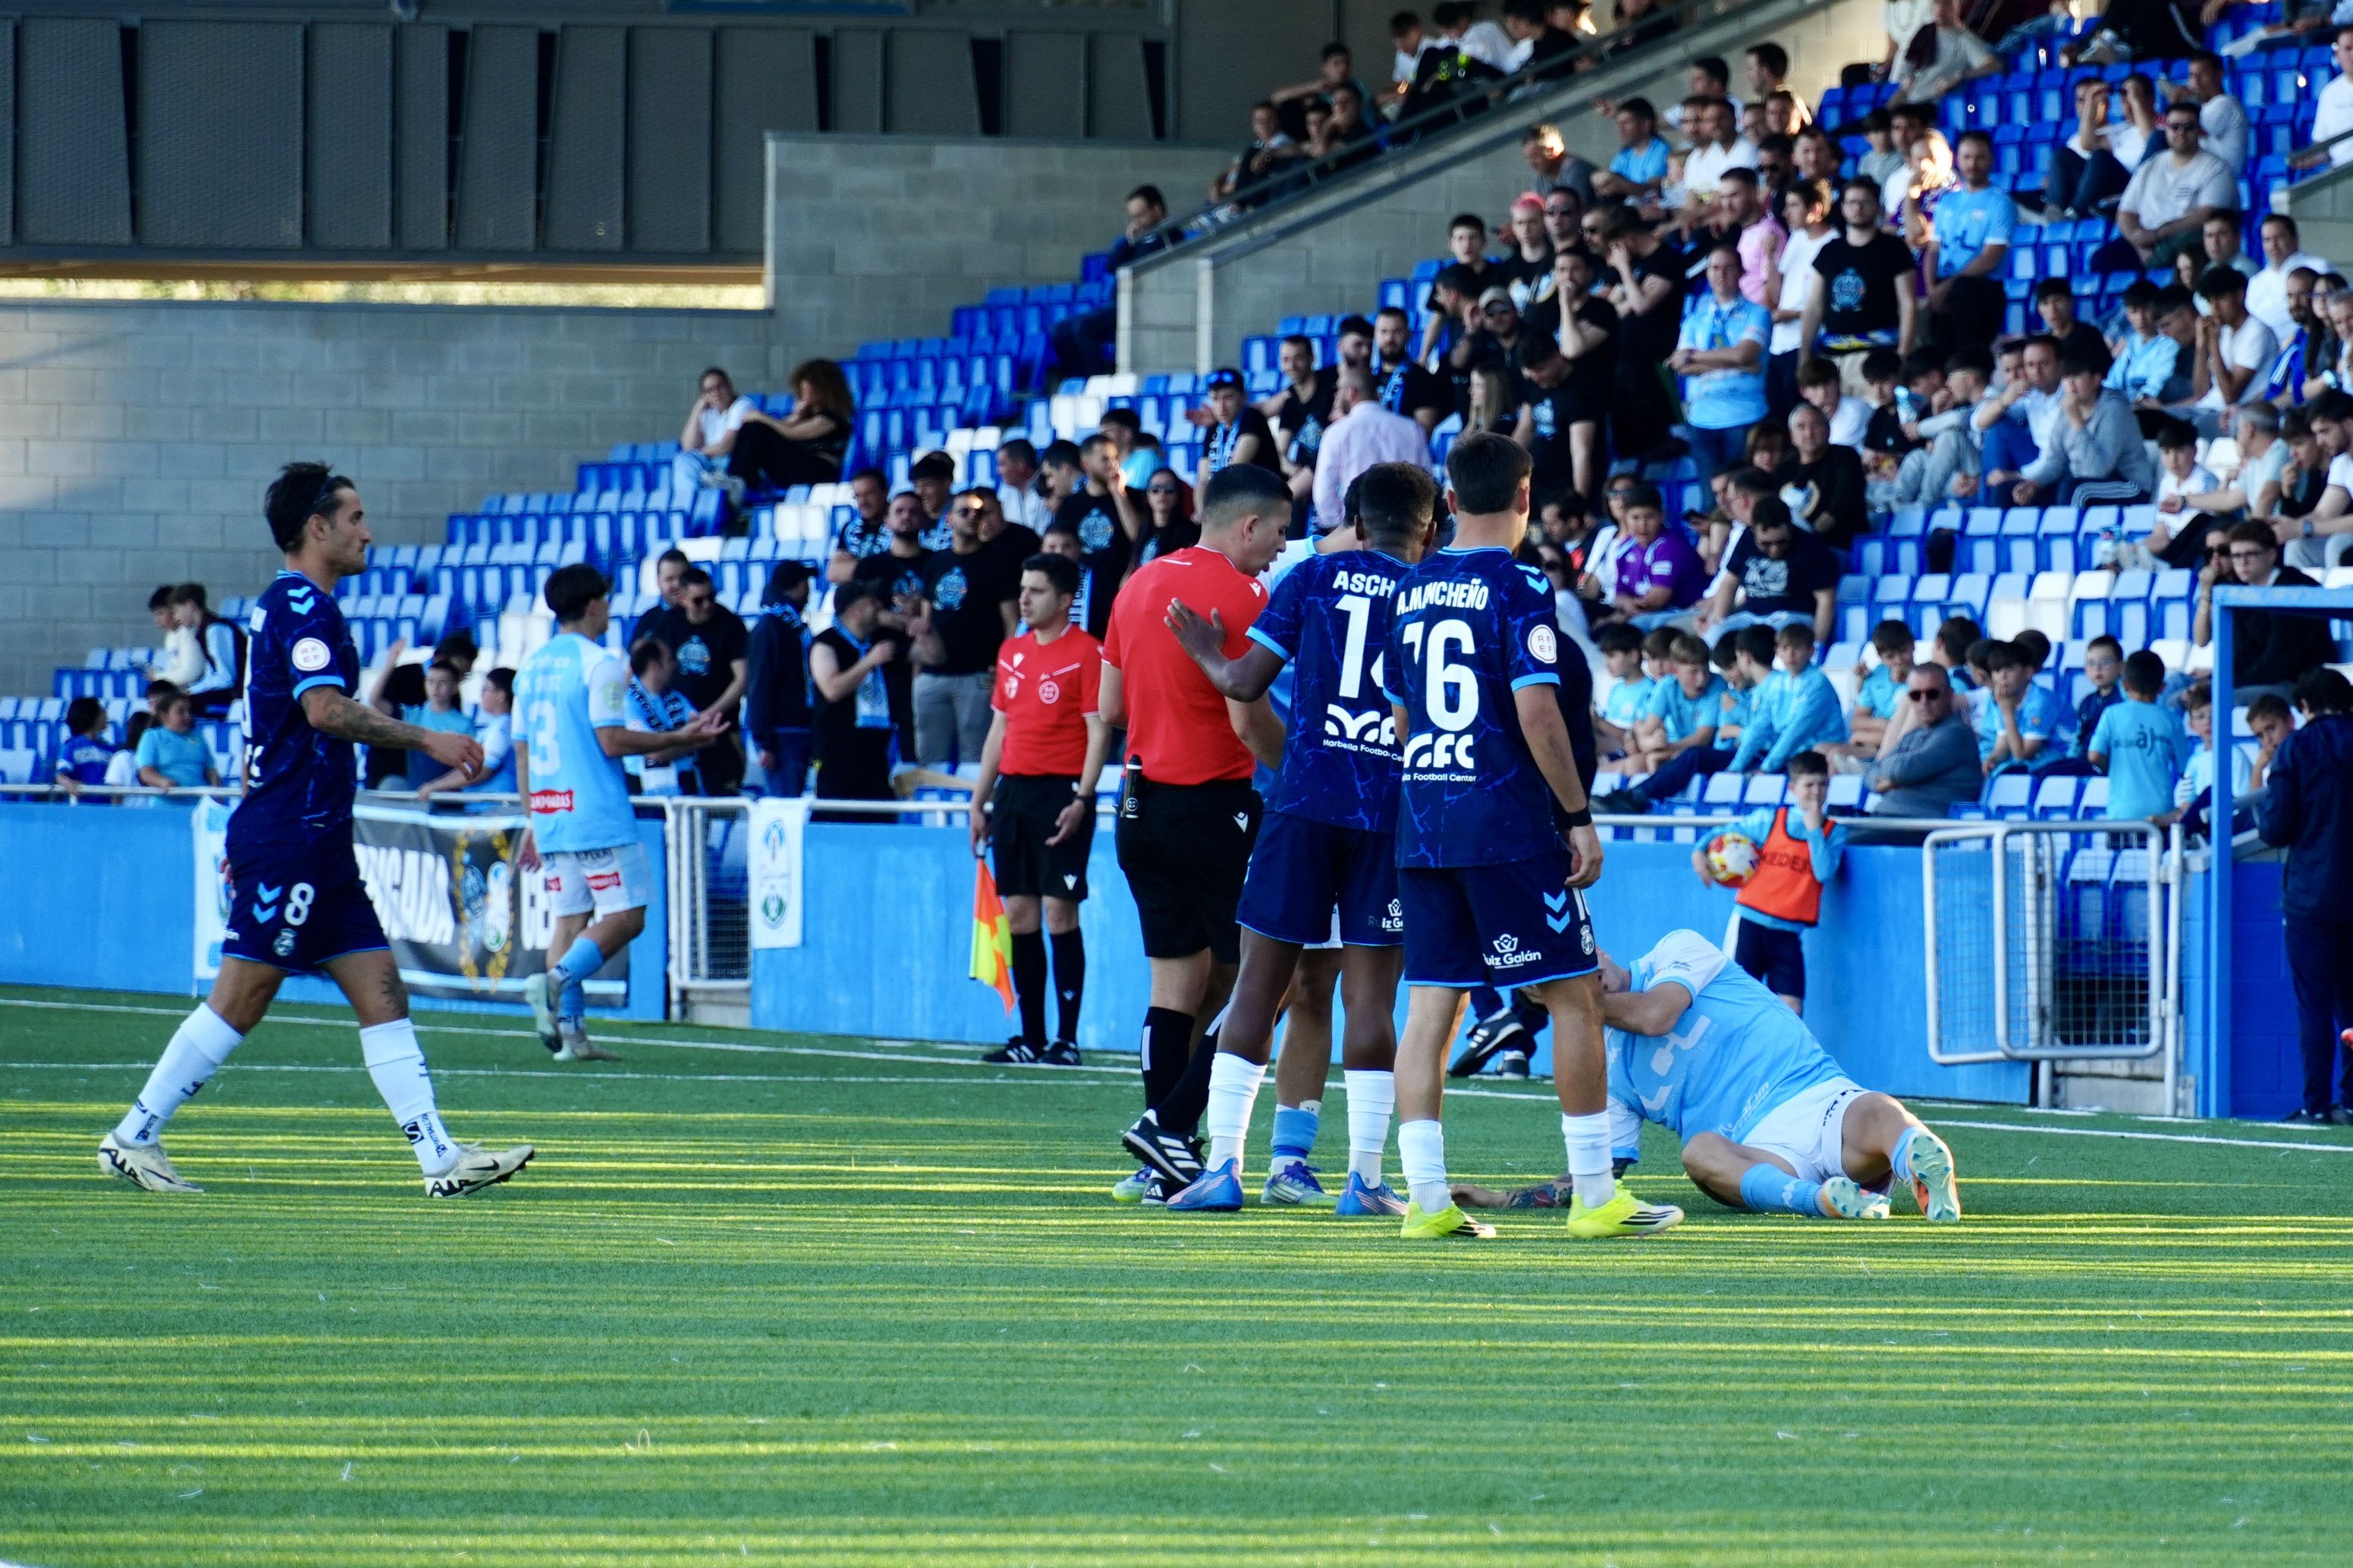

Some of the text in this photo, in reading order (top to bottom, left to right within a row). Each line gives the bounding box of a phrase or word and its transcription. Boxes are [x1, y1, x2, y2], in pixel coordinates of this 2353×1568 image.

[1413, 772, 1447, 782] Football
[1449, 773, 1477, 782] Center
[284, 881, 316, 926] 8
[1503, 950, 1541, 965] Galán
